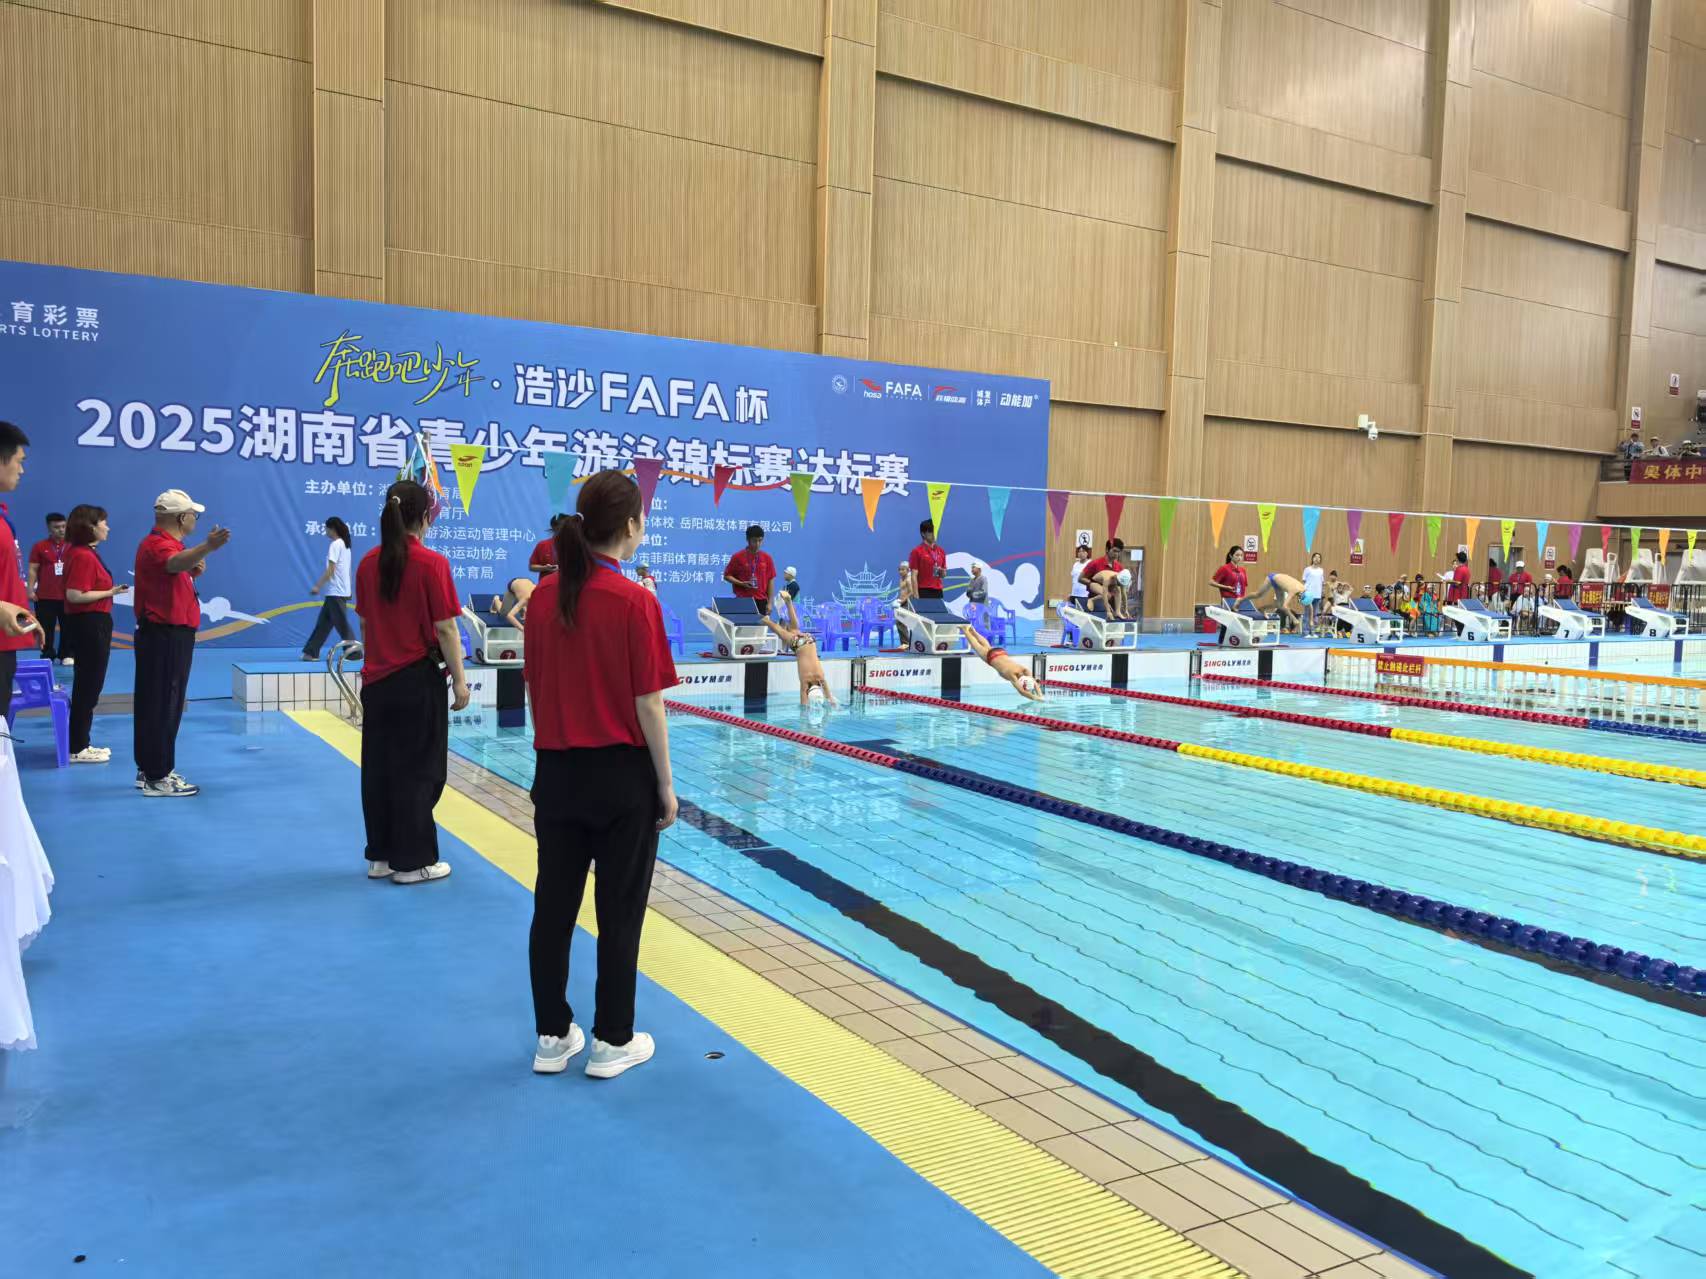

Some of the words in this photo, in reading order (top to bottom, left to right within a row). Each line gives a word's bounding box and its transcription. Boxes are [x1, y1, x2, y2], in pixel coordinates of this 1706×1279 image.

[10, 301, 100, 328] 育彩票
[33, 327, 99, 342] LOTTERY
[513, 363, 769, 425] 浩沙FAFA杯
[885, 381, 922, 397] FAFA
[1357, 633, 1365, 643] 5
[1467, 631, 1475, 640] 6
[1563, 630, 1570, 638] 7
[1650, 629, 1657, 637] 8
